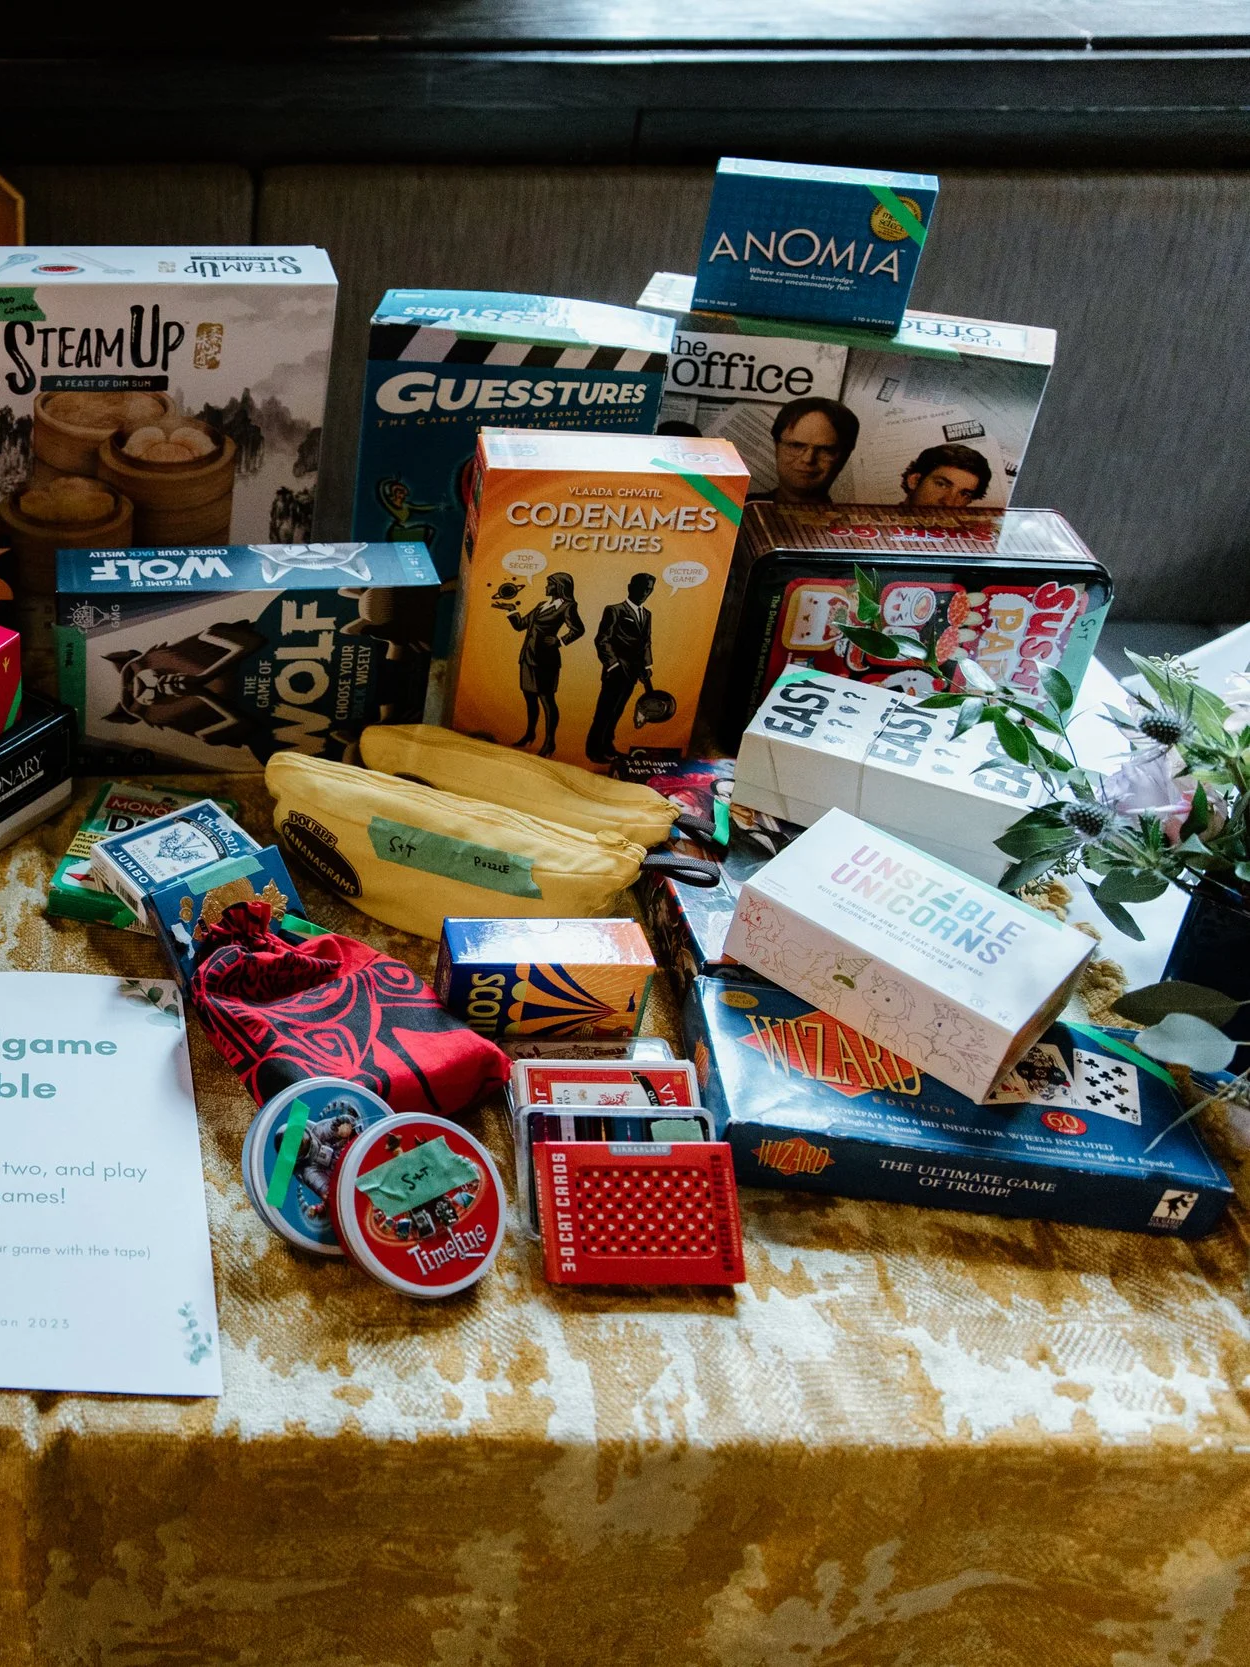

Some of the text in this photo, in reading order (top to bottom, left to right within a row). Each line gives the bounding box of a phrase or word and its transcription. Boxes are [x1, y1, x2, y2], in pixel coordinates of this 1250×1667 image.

[708, 228, 900, 283] ANOMIA
[750, 267, 854, 285] Where common knowledge
[750, 275, 850, 291] becomes uncommonly fun
[962, 337, 1002, 348] the
[672, 353, 814, 396] office
[376, 371, 647, 415] GUESSTURES
[377, 419, 408, 428] THE
[417, 416, 458, 425] GAME
[489, 413, 527, 422] SPLIT
[533, 411, 580, 419] SECOND
[586, 408, 643, 417] CHARADES
[568, 486, 663, 498] VLAADA CHVÁTIL
[506, 501, 717, 531] CODENAMES
[89, 548, 228, 559] CHOOSE YOUR PACK WISELY
[550, 532, 663, 553] PICTURES
[89, 555, 234, 581] WOLF
[509, 562, 539, 570] SECRET
[517, 554, 534, 562] TOP
[145, 579, 172, 587] GAME
[669, 567, 703, 576] PICTURE
[672, 575, 697, 583] GAME
[111, 603, 120, 629] GMG
[243, 659, 272, 710] THE GAME OF
[268, 599, 337, 757] WOLF
[334, 644, 355, 721] CHOOSE YOUR
[763, 678, 837, 739] EASY
[870, 698, 939, 767] EASY
[196, 812, 241, 855] VICTORIA
[288, 811, 338, 848] DOUBLE
[388, 835, 417, 858] S+T
[111, 849, 150, 886] JUMBO
[283, 826, 357, 894] BANANAGRAMS
[830, 863, 1007, 965] UNICORNS
[746, 1014, 922, 1097] WIZARD
[872, 1095, 956, 1116] EDITION
[886, 1114, 910, 1125] AND
[921, 1120, 940, 1129] BID
[942, 1123, 1006, 1138] INDICATOR
[1008, 1132, 1053, 1145] WHEELS
[1055, 1138, 1114, 1151] INCLUDED
[1047, 1112, 1080, 1130] 60
[757, 1138, 834, 1174] WIZARD
[2, 1161, 48, 1179] two,
[55, 1161, 94, 1177] and
[104, 1161, 147, 1182] play
[879, 1159, 1058, 1193] THE ULTIMATE GAME
[919, 1177, 1012, 1198] OF TRUMP!
[551, 1152, 577, 1273] 3-D CAT CARDS
[11, 1246, 51, 1257] game
[55, 1245, 84, 1256] with
[87, 1245, 110, 1257] the
[114, 1246, 151, 1259] tape)
[407, 1223, 488, 1276] Timeline
[28, 1316, 71, 1330] 2023
